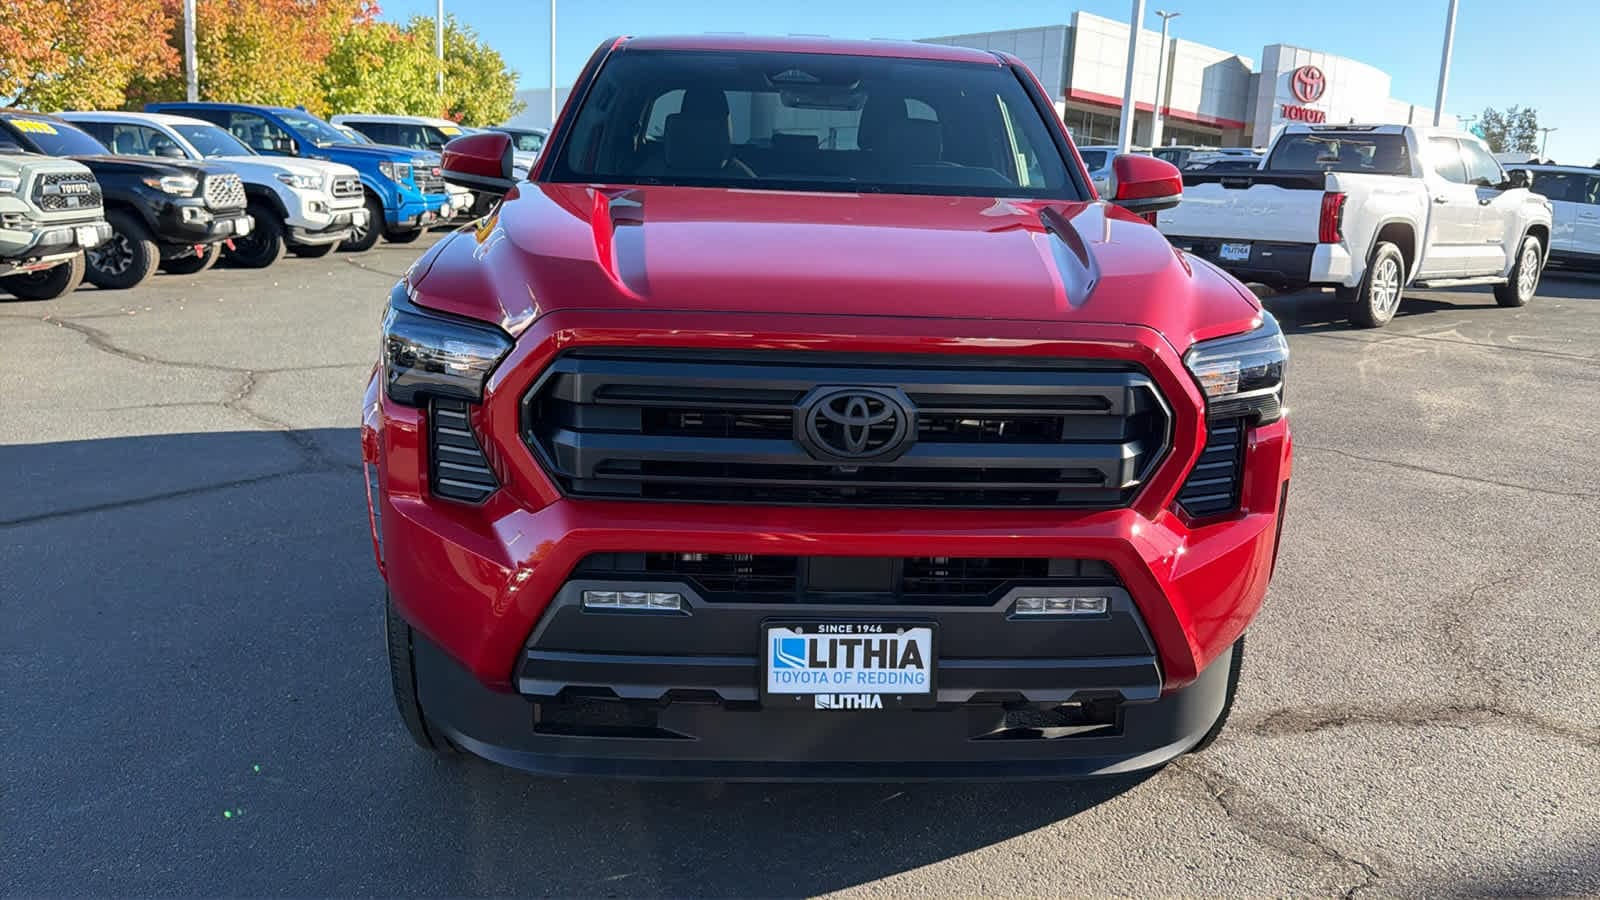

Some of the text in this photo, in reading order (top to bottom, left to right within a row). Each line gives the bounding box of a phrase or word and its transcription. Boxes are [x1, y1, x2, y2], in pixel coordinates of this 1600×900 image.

[1280, 104, 1326, 124] TOYOTA
[60, 182, 88, 194] TOYOTA
[818, 624, 883, 633] SINCE 1946
[808, 638, 925, 669] LITHIA
[773, 671, 925, 685] TOYOTA OF REDDING
[830, 693, 883, 709] LITHIA
